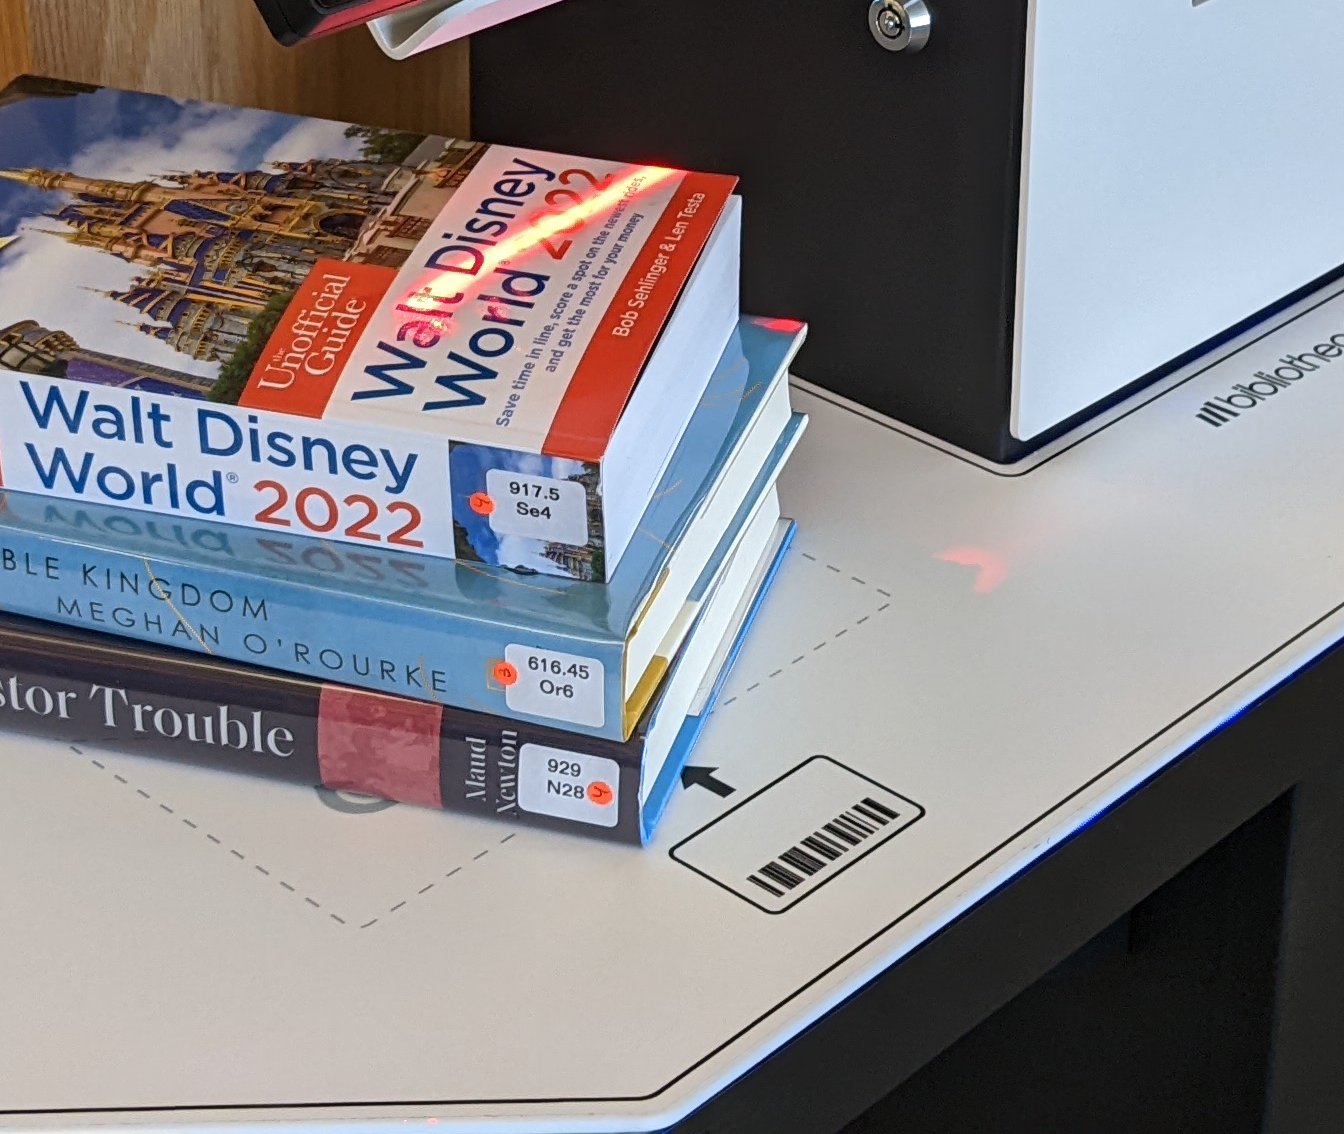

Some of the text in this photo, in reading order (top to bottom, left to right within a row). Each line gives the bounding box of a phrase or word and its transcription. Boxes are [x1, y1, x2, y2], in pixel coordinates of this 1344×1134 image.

[350, 156, 556, 402] Walt Disney
[545, 211, 645, 373] and get the most for your money
[611, 191, 706, 338] Bob Sehlinger & Len Testa
[257, 272, 352, 391] Unofficial
[303, 296, 367, 377] Guide
[496, 175, 647, 427] Save time in line, score a spot on the newest rides,
[272, 346, 286, 364] the
[19, 380, 419, 495] Walt Disney
[252, 479, 425, 548] 2022
[508, 480, 562, 502] 917.5
[516, 500, 553, 521] Se4
[81, 562, 270, 623] KINGDOM
[57, 595, 448, 694] MEGHAN O'ROURKE
[527, 655, 591, 681] 616.45
[87, 683, 296, 759] Trouble
[539, 678, 576, 700] Or6
[464, 734, 488, 803] Maud
[494, 727, 520, 817] Newton
[546, 778, 585, 801] N28
[547, 758, 582, 779] 929
